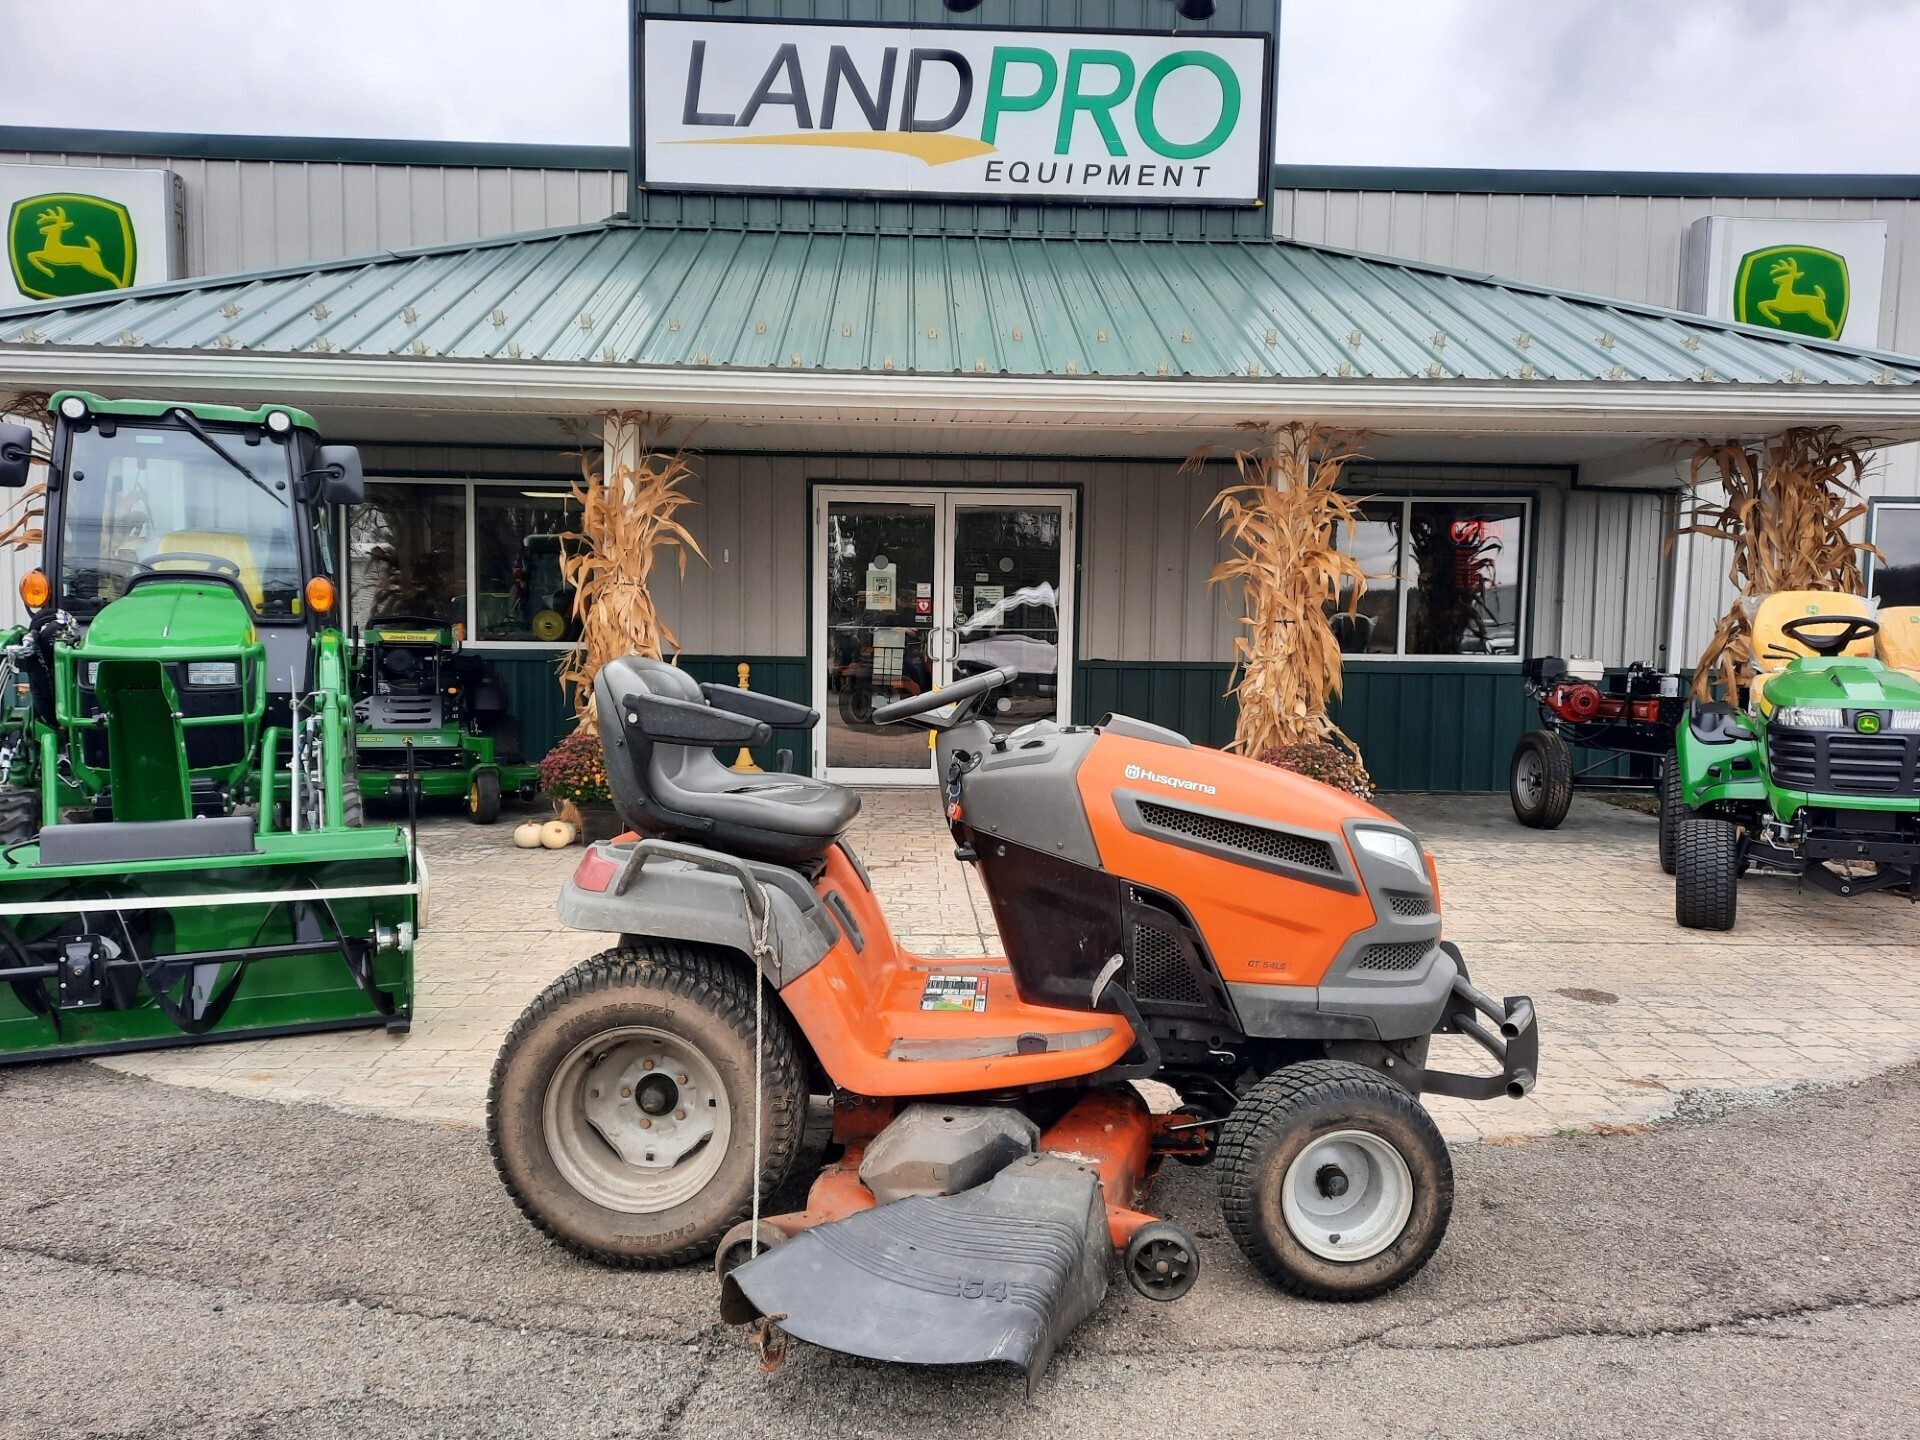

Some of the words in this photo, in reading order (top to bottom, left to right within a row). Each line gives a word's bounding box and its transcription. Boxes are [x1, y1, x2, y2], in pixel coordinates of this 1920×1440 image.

[682, 39, 1241, 159] LANDPRO
[985, 160, 1211, 187] EQUIPMENT
[1450, 520, 1504, 543] OPEN
[1140, 768, 1216, 796] Husqvarna
[1247, 960, 1261, 968] GT
[1262, 961, 1287, 970] 54LS
[602, 1002, 675, 1019] MASTER
[961, 1278, 1008, 1303] 54
